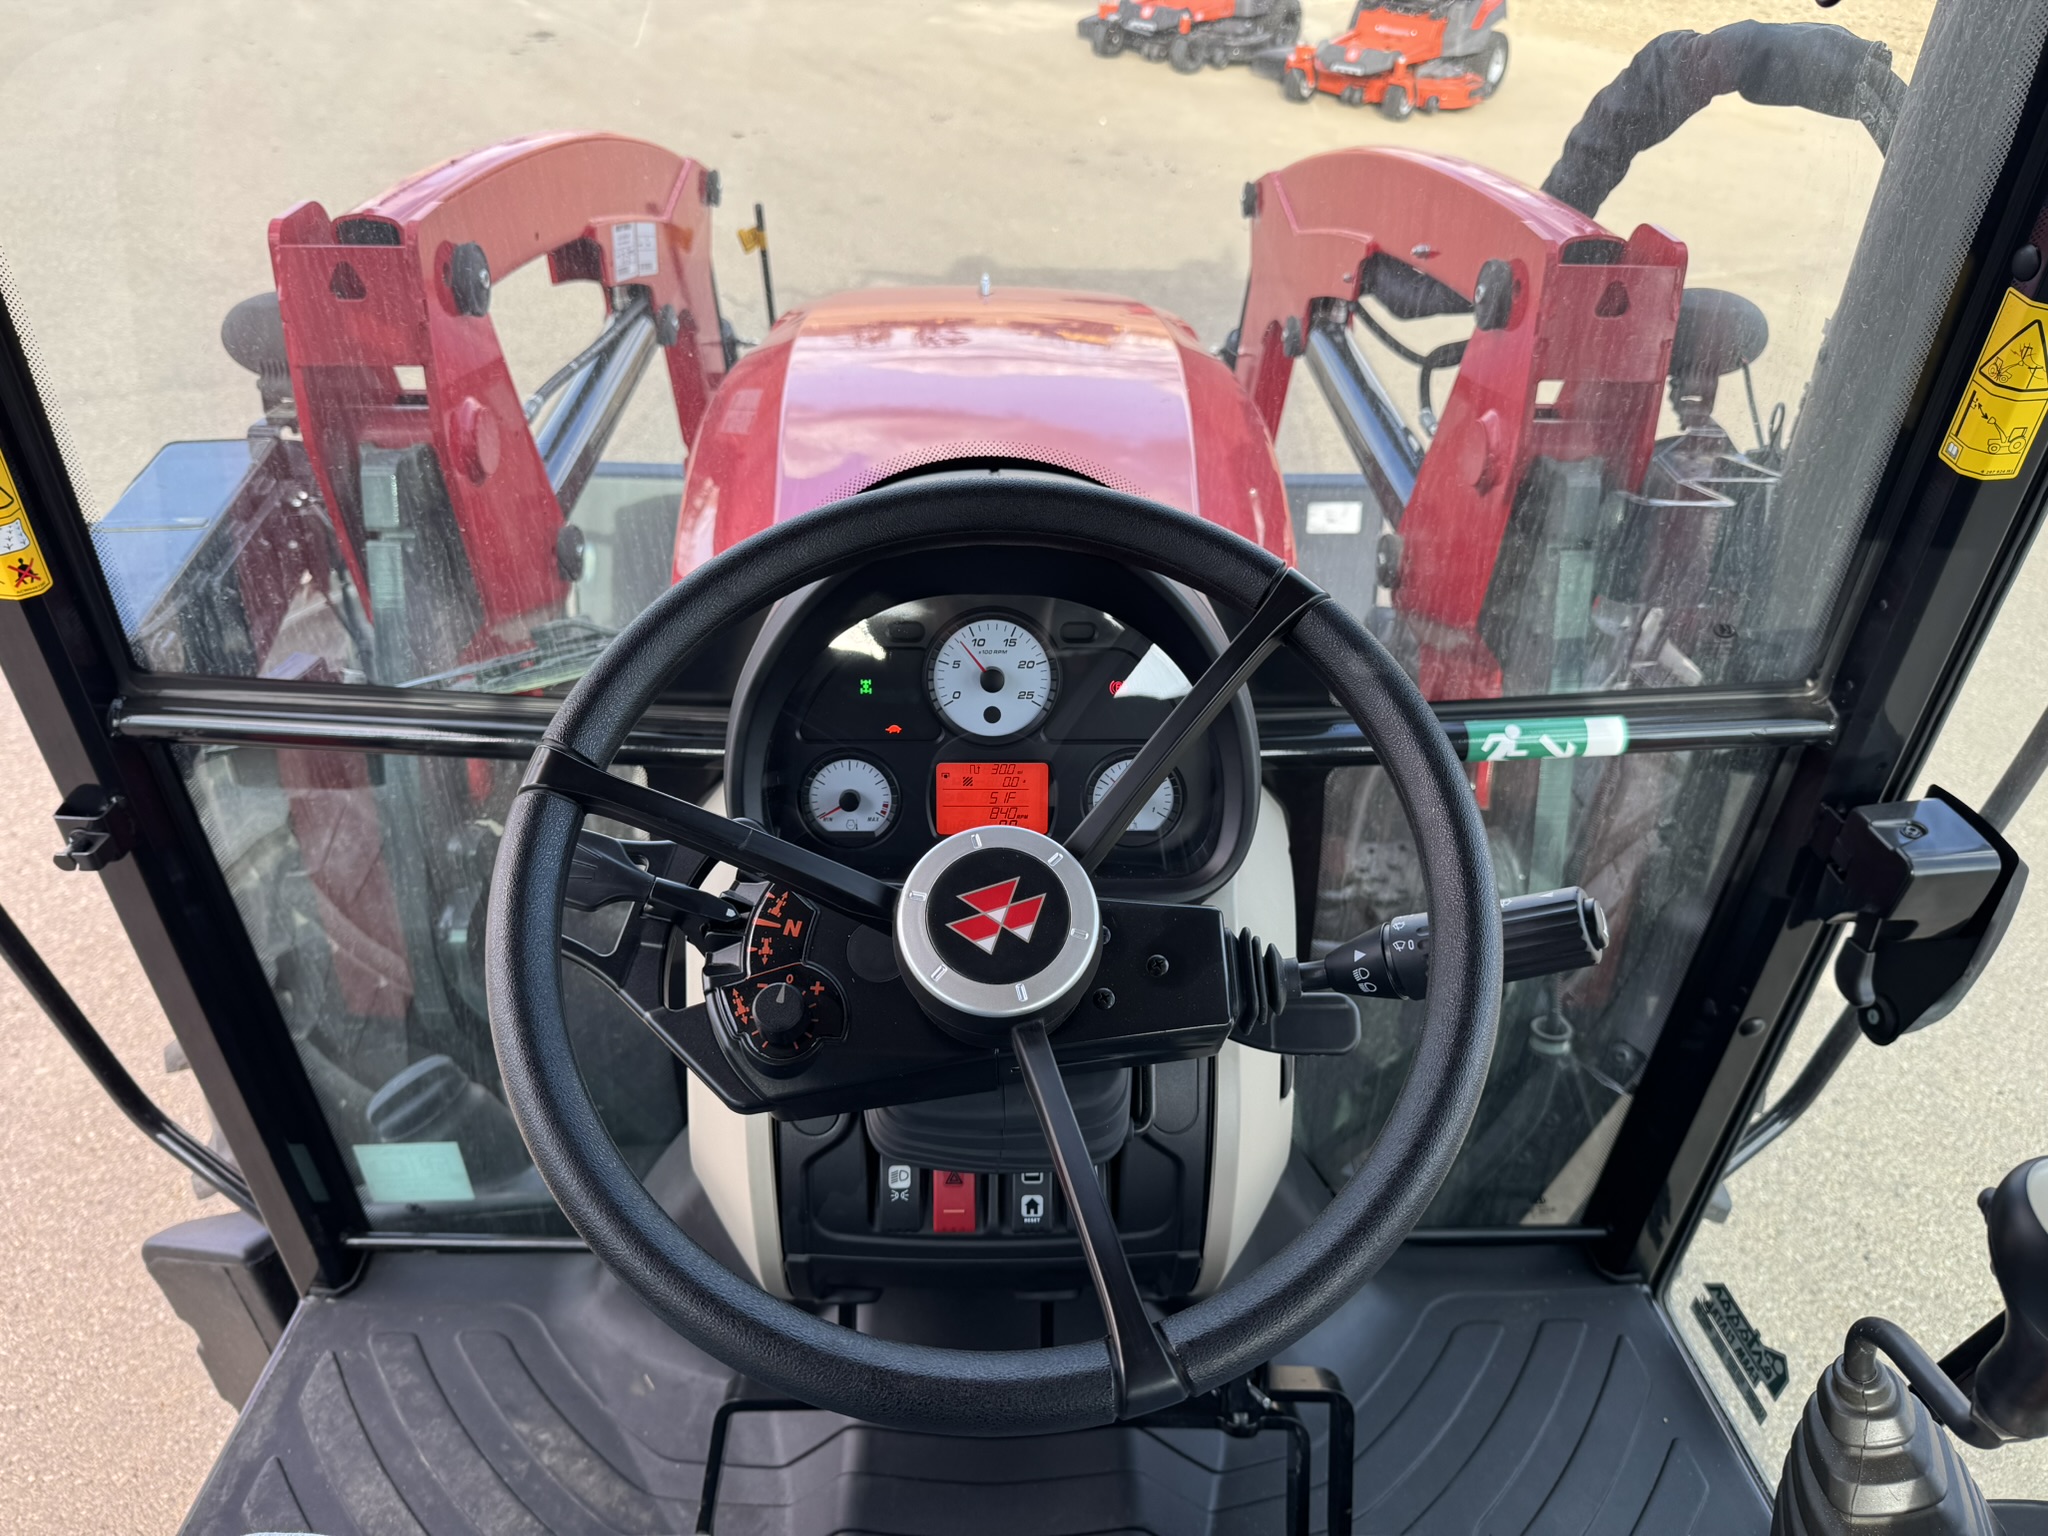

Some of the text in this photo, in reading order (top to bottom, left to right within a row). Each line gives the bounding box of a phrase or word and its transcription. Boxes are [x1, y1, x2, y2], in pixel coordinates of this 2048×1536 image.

[972, 638, 986, 647] 10
[1003, 638, 1017, 647] 15
[952, 660, 961, 669] 5
[1017, 660, 1035, 669] 20
[952, 691, 961, 699] 0
[1017, 691, 1035, 700] 25
[989, 807, 1018, 819] 840
[782, 918, 803, 938] N
[785, 973, 794, 984] 0
